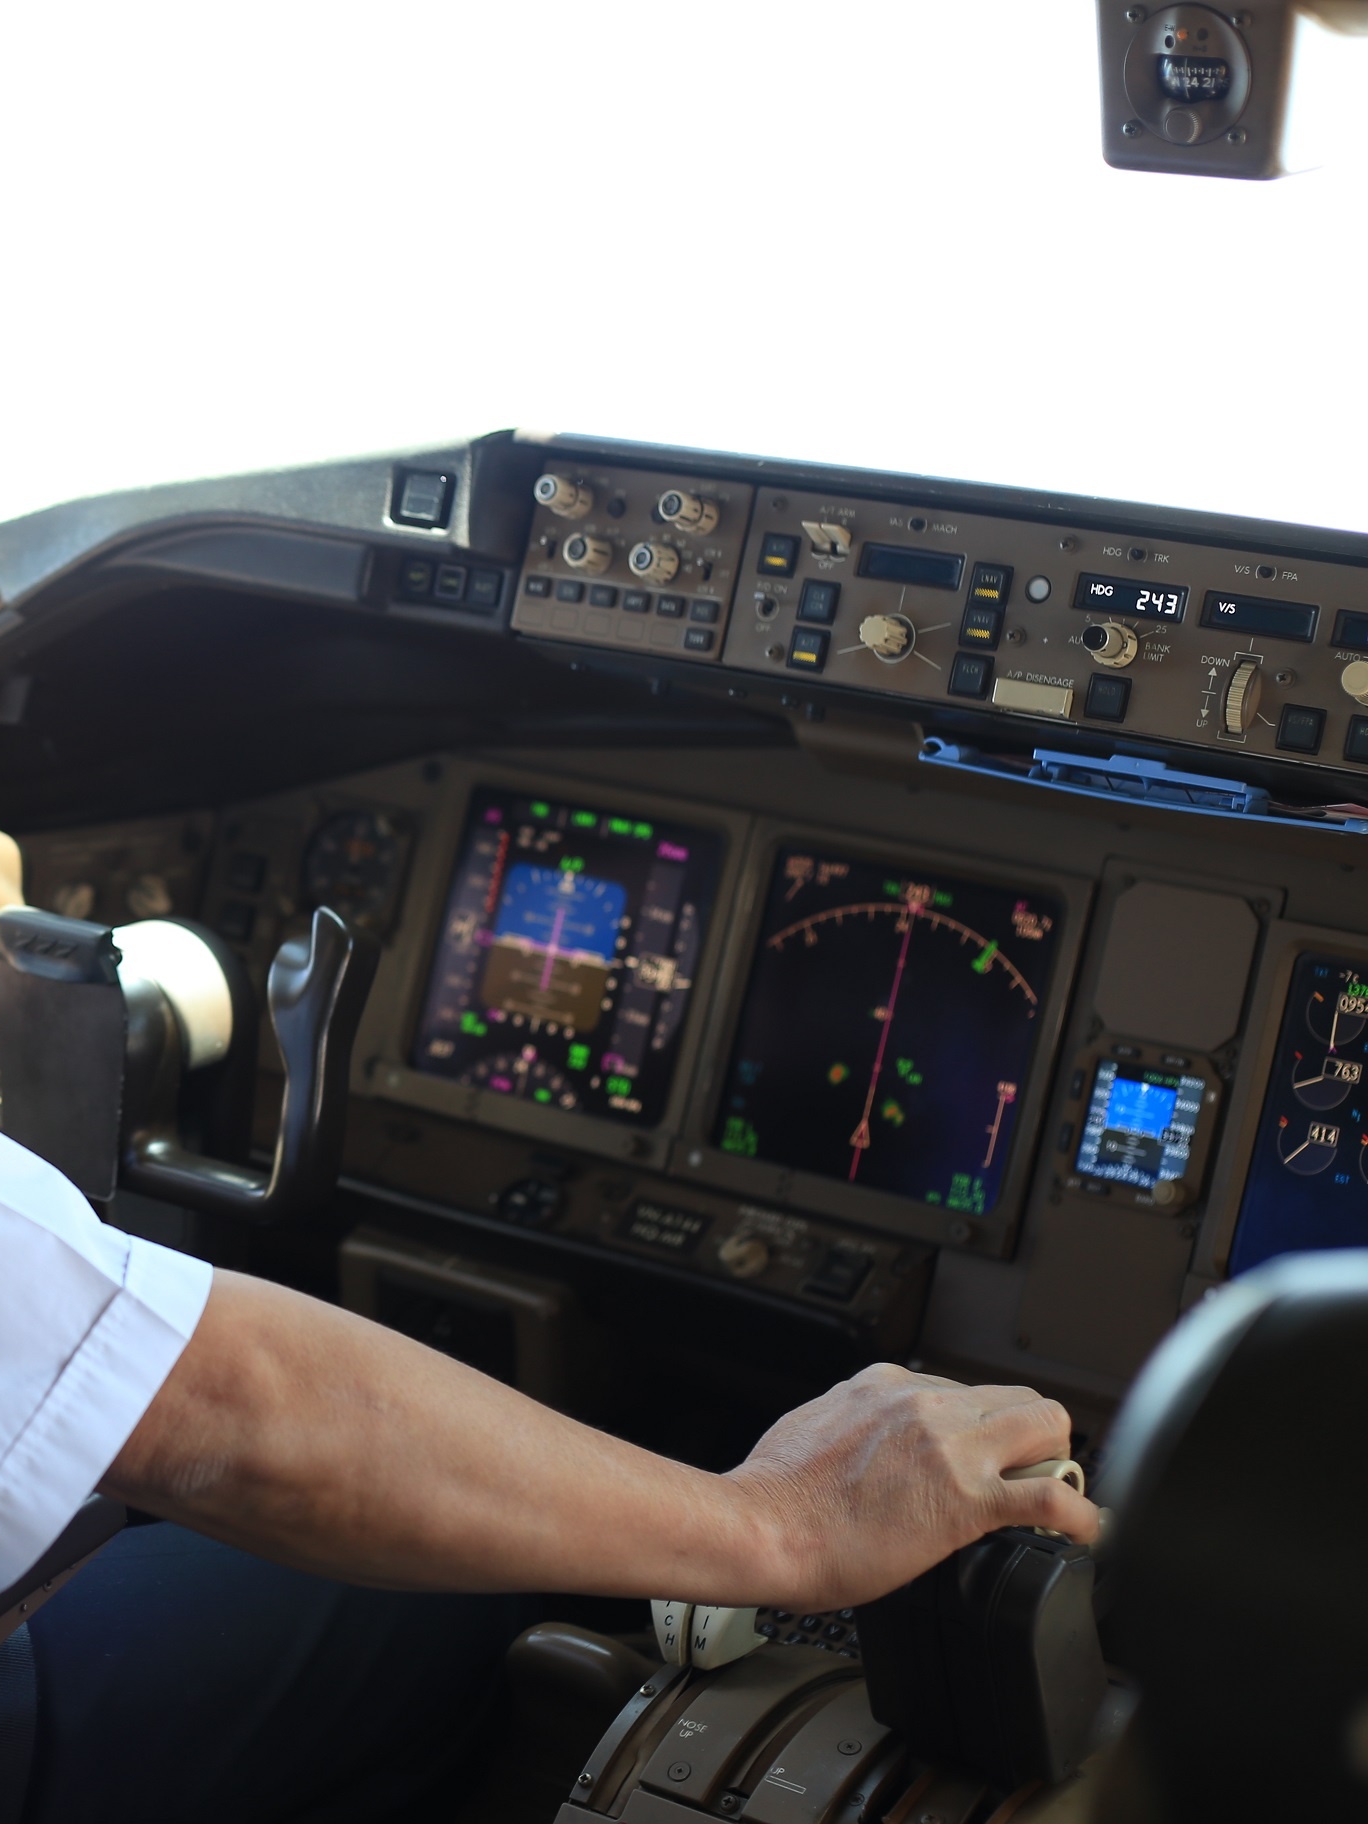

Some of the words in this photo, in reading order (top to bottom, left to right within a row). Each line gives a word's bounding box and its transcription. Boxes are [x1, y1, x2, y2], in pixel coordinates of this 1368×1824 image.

[932, 523, 958, 535] MACH
[1102, 547, 1122, 557] HDG
[1153, 553, 1170, 564] TRK
[1234, 565, 1251, 575] V/S
[1281, 571, 1298, 581] FPA
[1090, 583, 1114, 597] HDG
[1136, 590, 1178, 615] 243
[1218, 601, 1236, 614] V/S
[1155, 625, 1167, 634] 25
[1145, 642, 1171, 654] BANK
[1142, 652, 1164, 663] LIMIT
[1200, 655, 1231, 667] DOWN
[1334, 651, 1361, 662] AUTO
[1006, 671, 1023, 680] A/P
[1025, 672, 1075, 689] DISENGAGE
[1196, 719, 1209, 728] UP
[1311, 1125, 1337, 1145] 414
[678, 1718, 708, 1733] NOSE
[679, 1729, 693, 1738] UP
